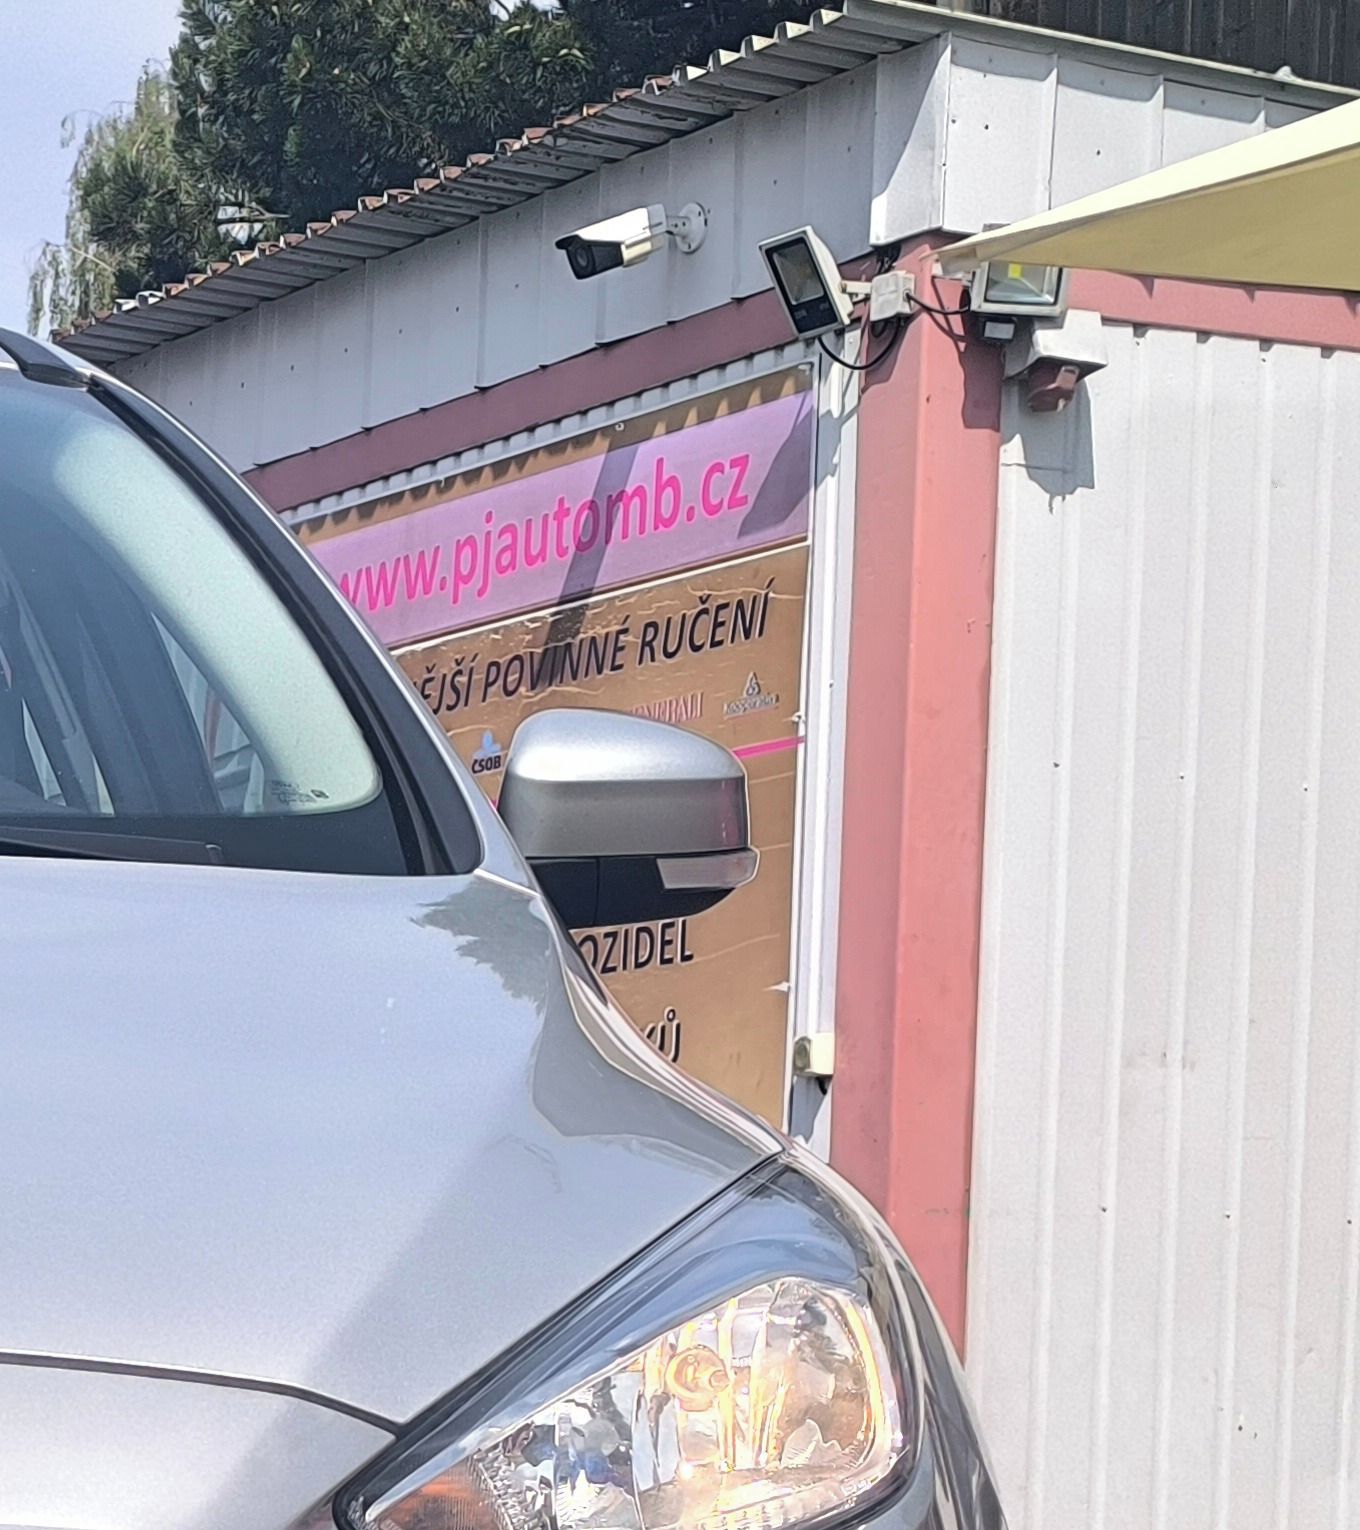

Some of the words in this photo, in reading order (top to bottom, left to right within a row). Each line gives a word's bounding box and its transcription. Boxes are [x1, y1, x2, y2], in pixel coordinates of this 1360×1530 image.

[413, 652, 479, 716] ĚJŠÍ
[481, 622, 627, 703] POVINNÉ
[637, 578, 773, 666] RUČENÍ
